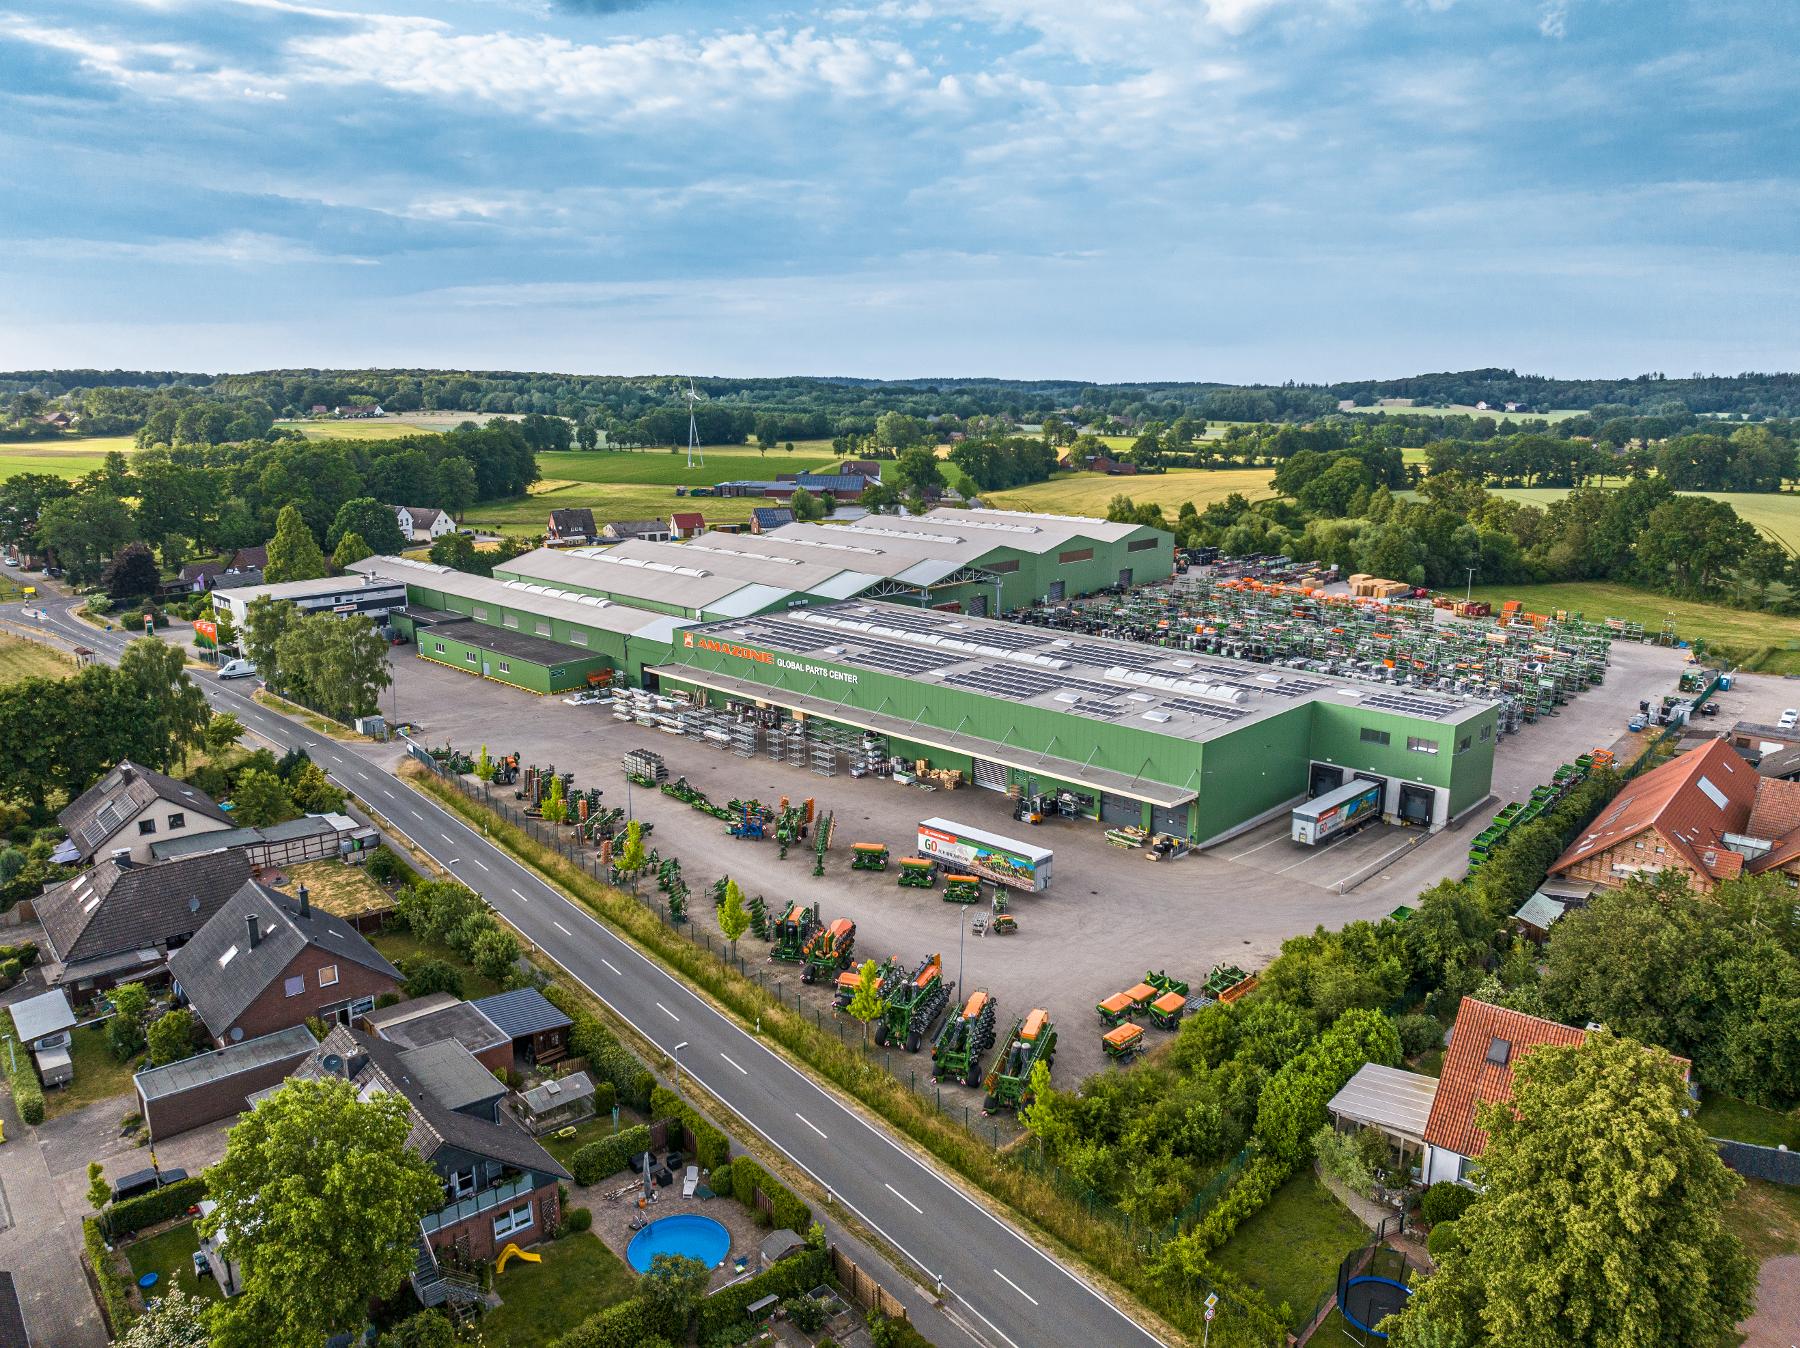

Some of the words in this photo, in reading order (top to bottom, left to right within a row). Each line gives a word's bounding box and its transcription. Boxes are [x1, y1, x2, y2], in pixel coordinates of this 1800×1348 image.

[698, 638, 775, 665] AMAZONE
[777, 658, 804, 672] GLOBAL
[805, 664, 828, 677] PARTS
[829, 670, 858, 684] CENTER
[925, 838, 937, 851] GO
